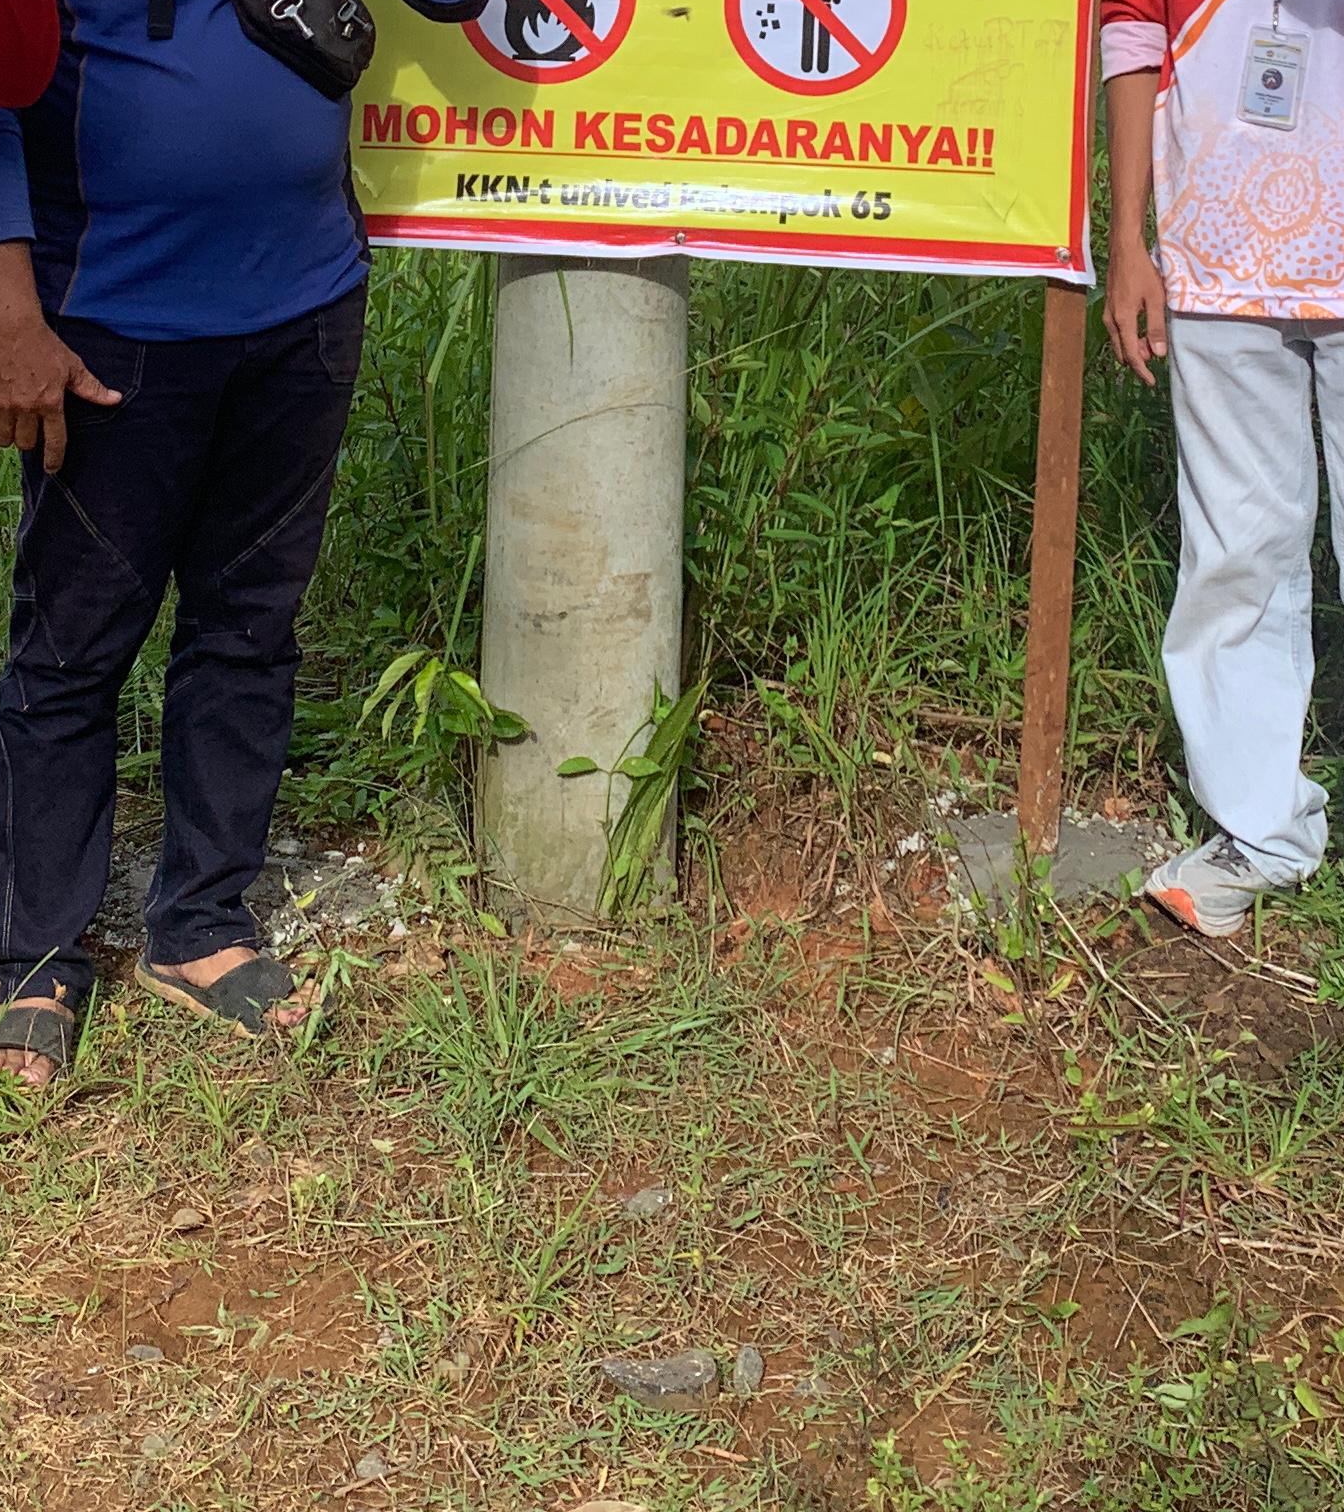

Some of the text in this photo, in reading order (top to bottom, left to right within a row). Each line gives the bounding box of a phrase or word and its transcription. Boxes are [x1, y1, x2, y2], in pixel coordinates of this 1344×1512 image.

[361, 103, 994, 166] MOHON KESADARANYA!!
[456, 173, 552, 204] KKN-t
[852, 190, 891, 220] 65
